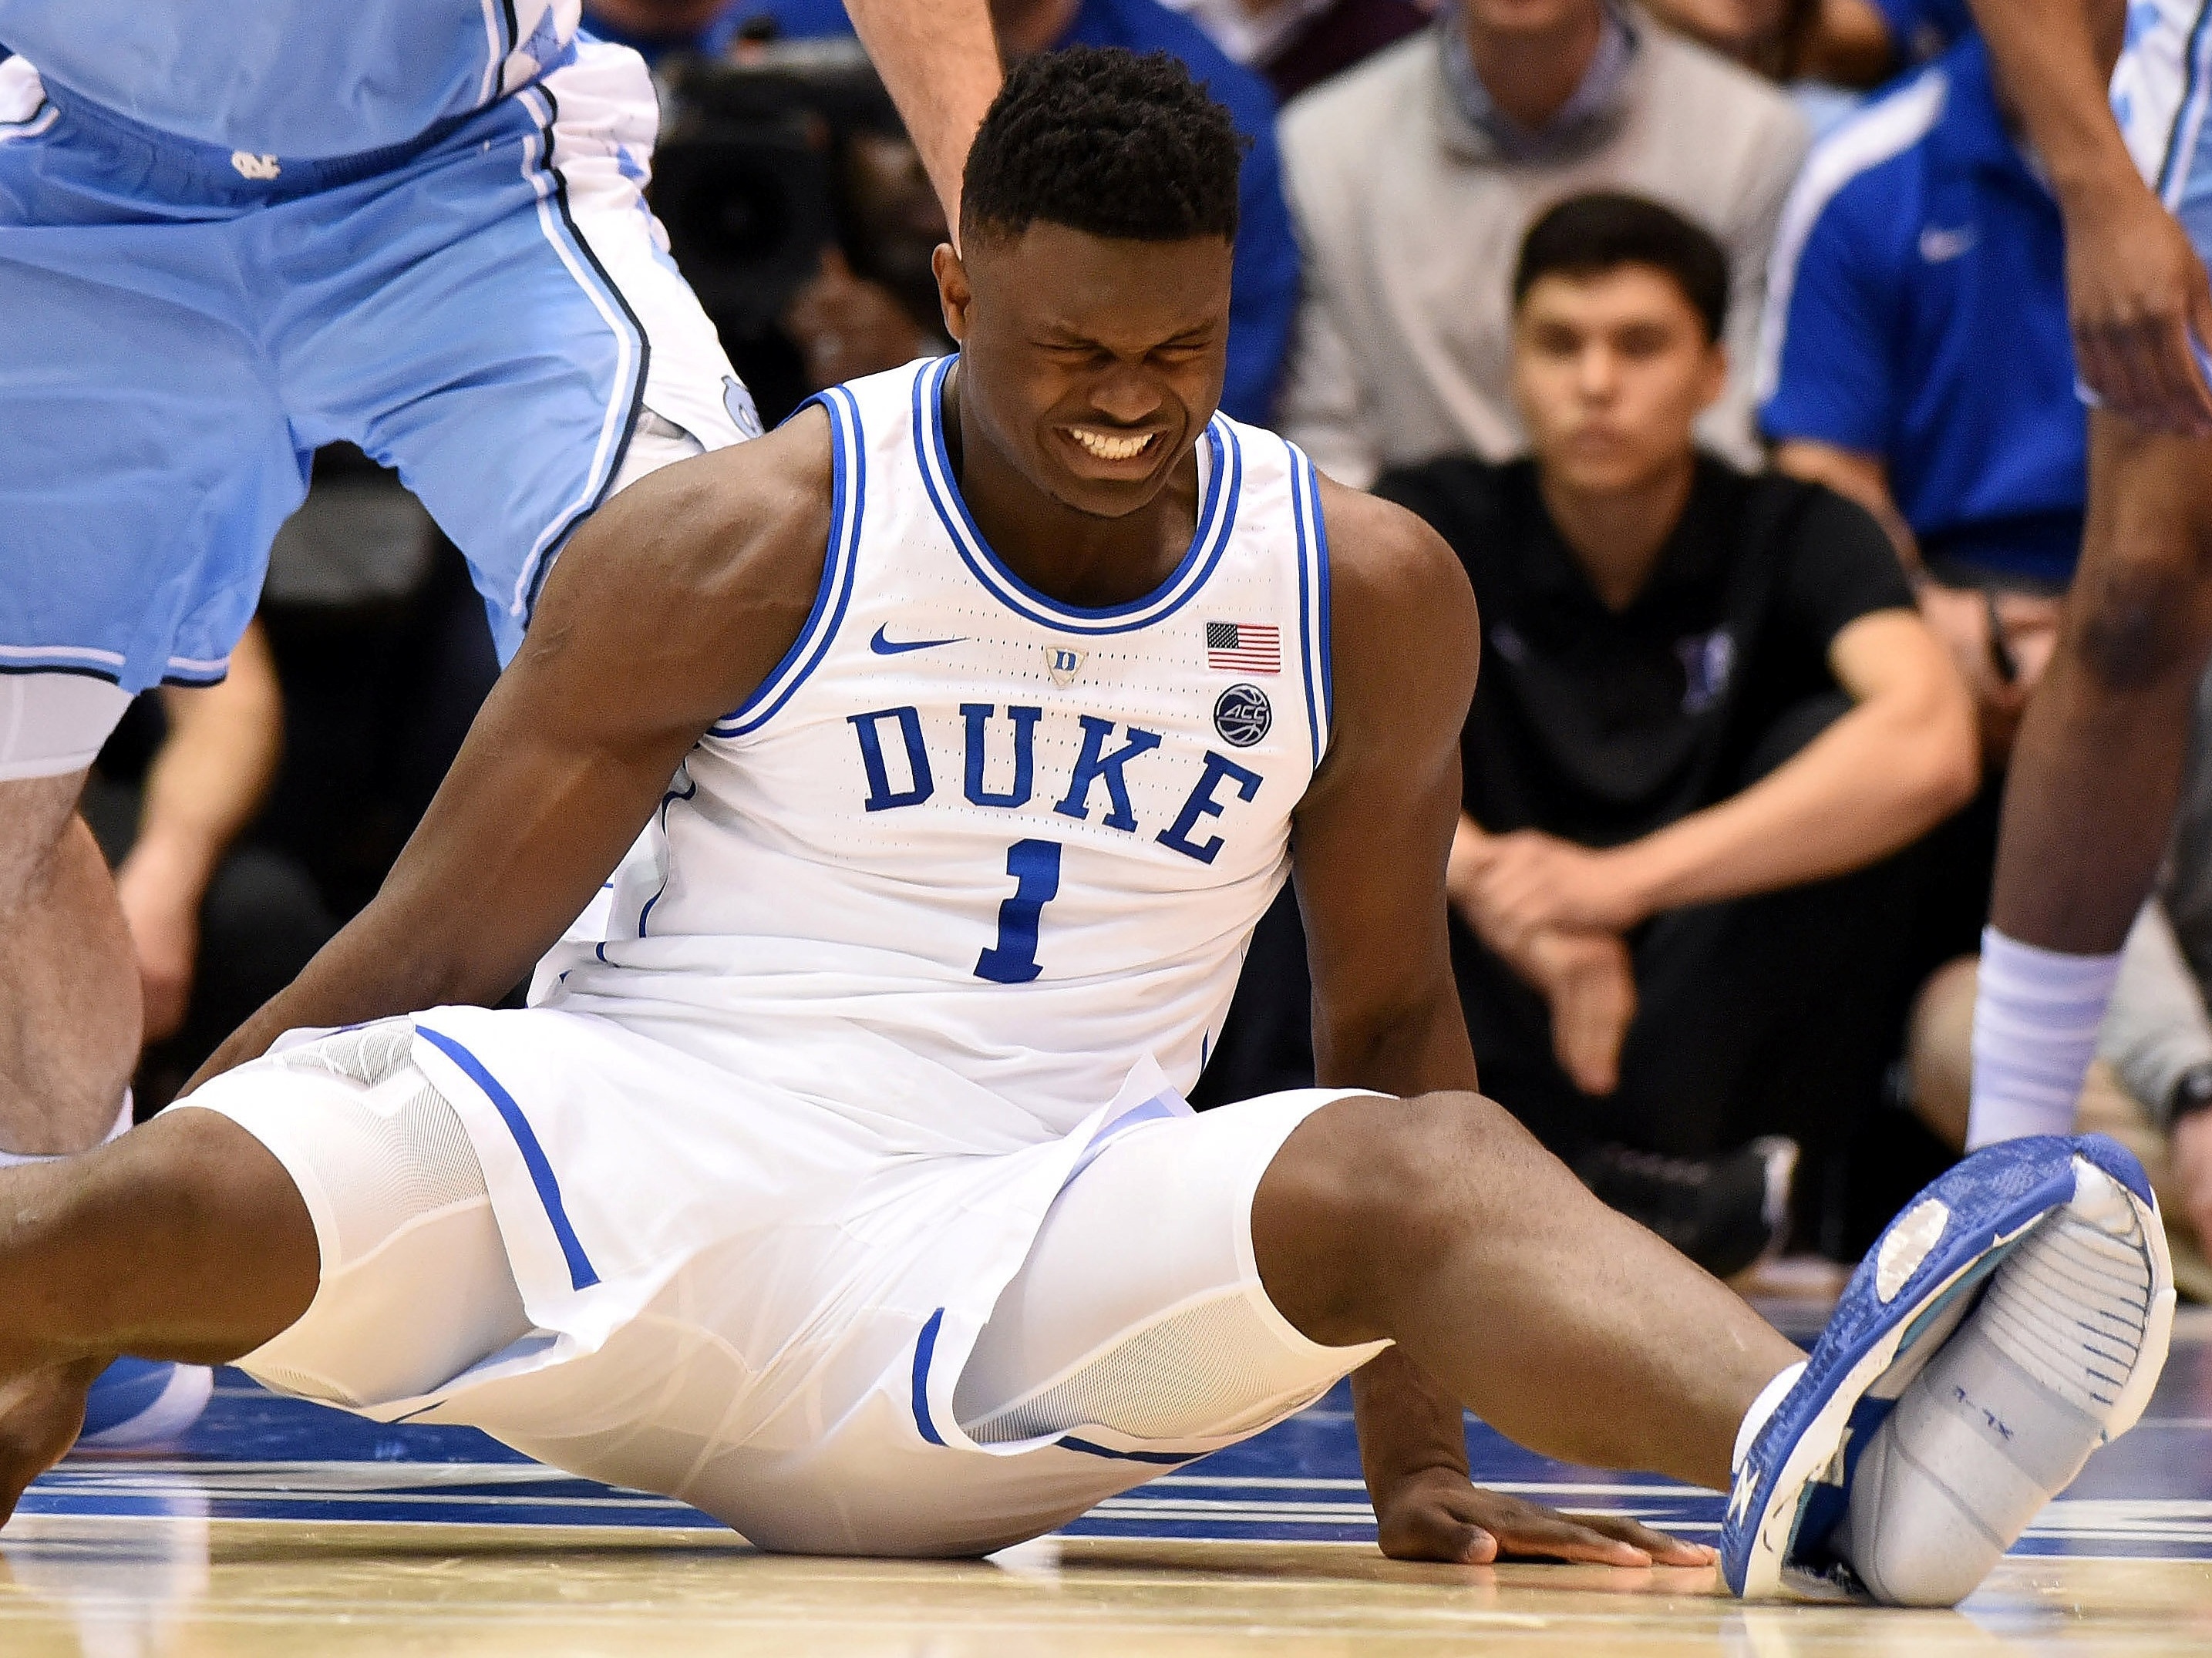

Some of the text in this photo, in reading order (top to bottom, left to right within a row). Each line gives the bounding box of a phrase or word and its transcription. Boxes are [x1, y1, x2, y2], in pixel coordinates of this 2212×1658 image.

[1055, 649, 1076, 671] D
[1224, 704, 1266, 720] ACC
[847, 703, 1263, 865] DUKE
[973, 839, 1062, 984] 1
